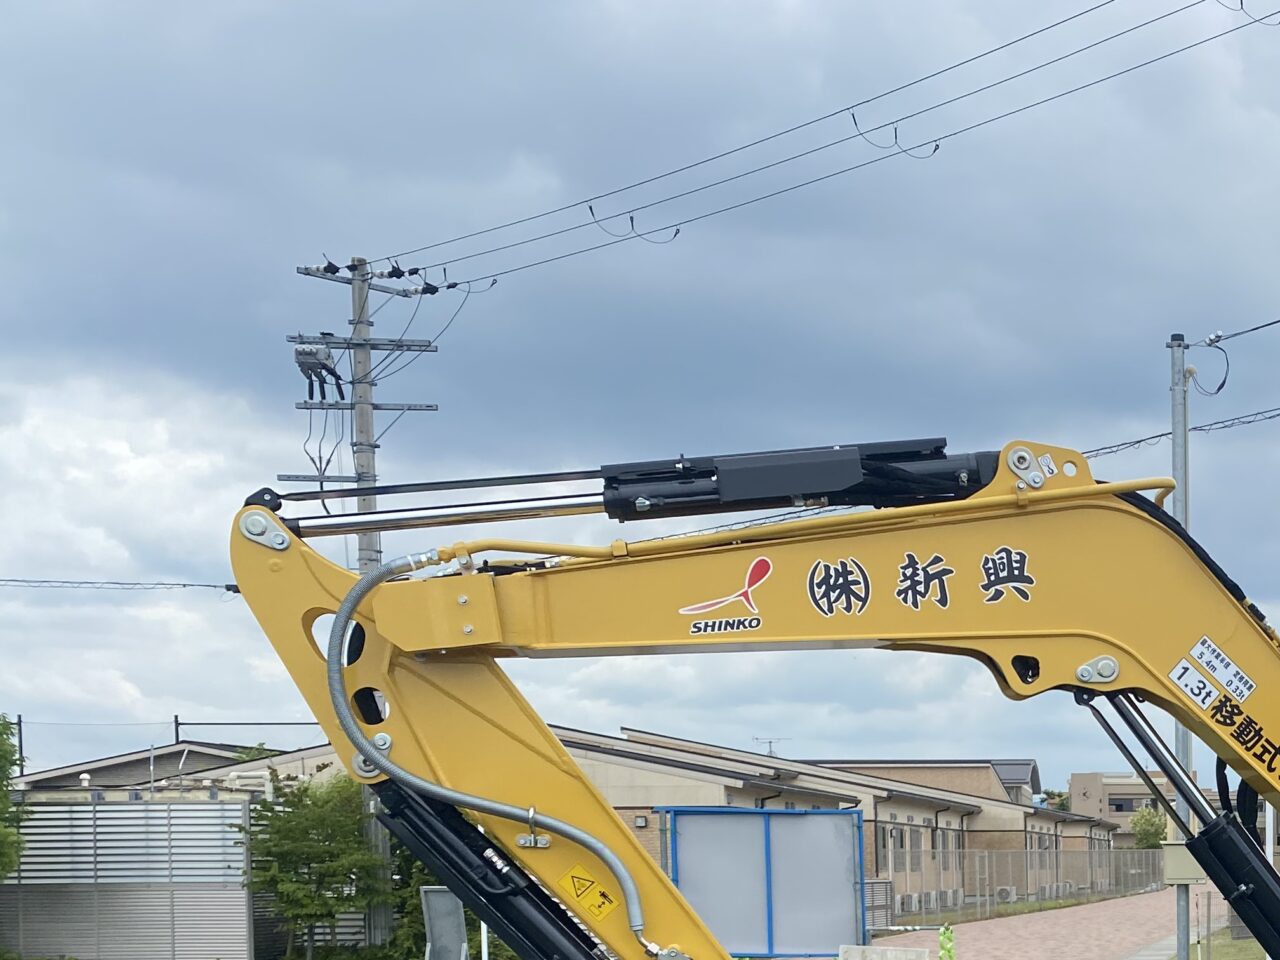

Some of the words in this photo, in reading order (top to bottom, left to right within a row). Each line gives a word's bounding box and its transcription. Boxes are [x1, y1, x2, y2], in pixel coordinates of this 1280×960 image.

[690, 617, 761, 634] SHINKO
[1176, 666, 1214, 706] 1.3t
[1197, 651, 1217, 674] 5.4m
[1225, 679, 1246, 701] 0.33t
